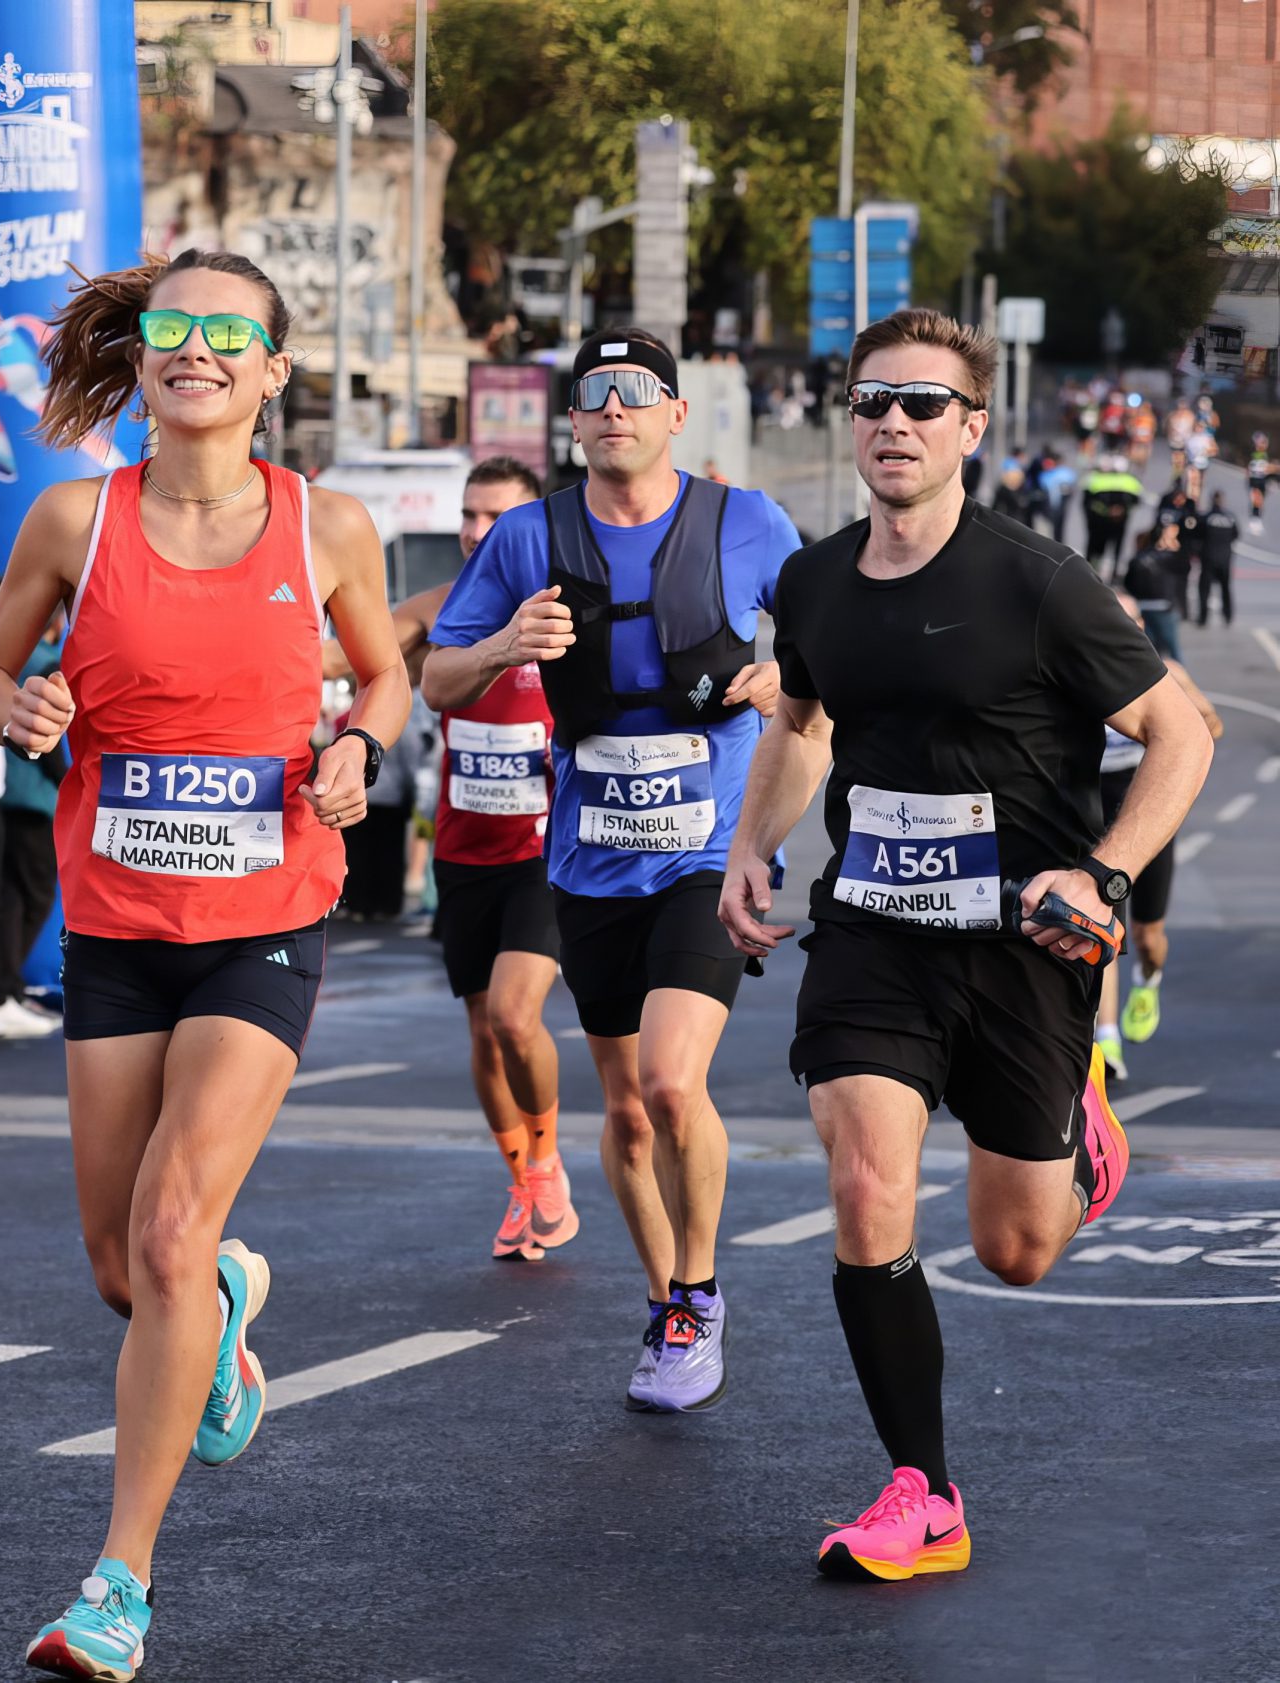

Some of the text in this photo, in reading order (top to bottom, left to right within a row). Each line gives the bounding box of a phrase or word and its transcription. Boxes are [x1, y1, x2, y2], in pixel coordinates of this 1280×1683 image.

[460, 752, 530, 778] B 1843
[124, 760, 256, 806] B 1250
[604, 774, 682, 806] A 891
[125, 818, 235, 846] ISTANBUL
[603, 814, 679, 833] ISTANBUL
[600, 834, 681, 849] MARATHON
[120, 846, 235, 871] MARATHON
[872, 842, 958, 879] A 561
[861, 889, 957, 913] ISTANBUL
